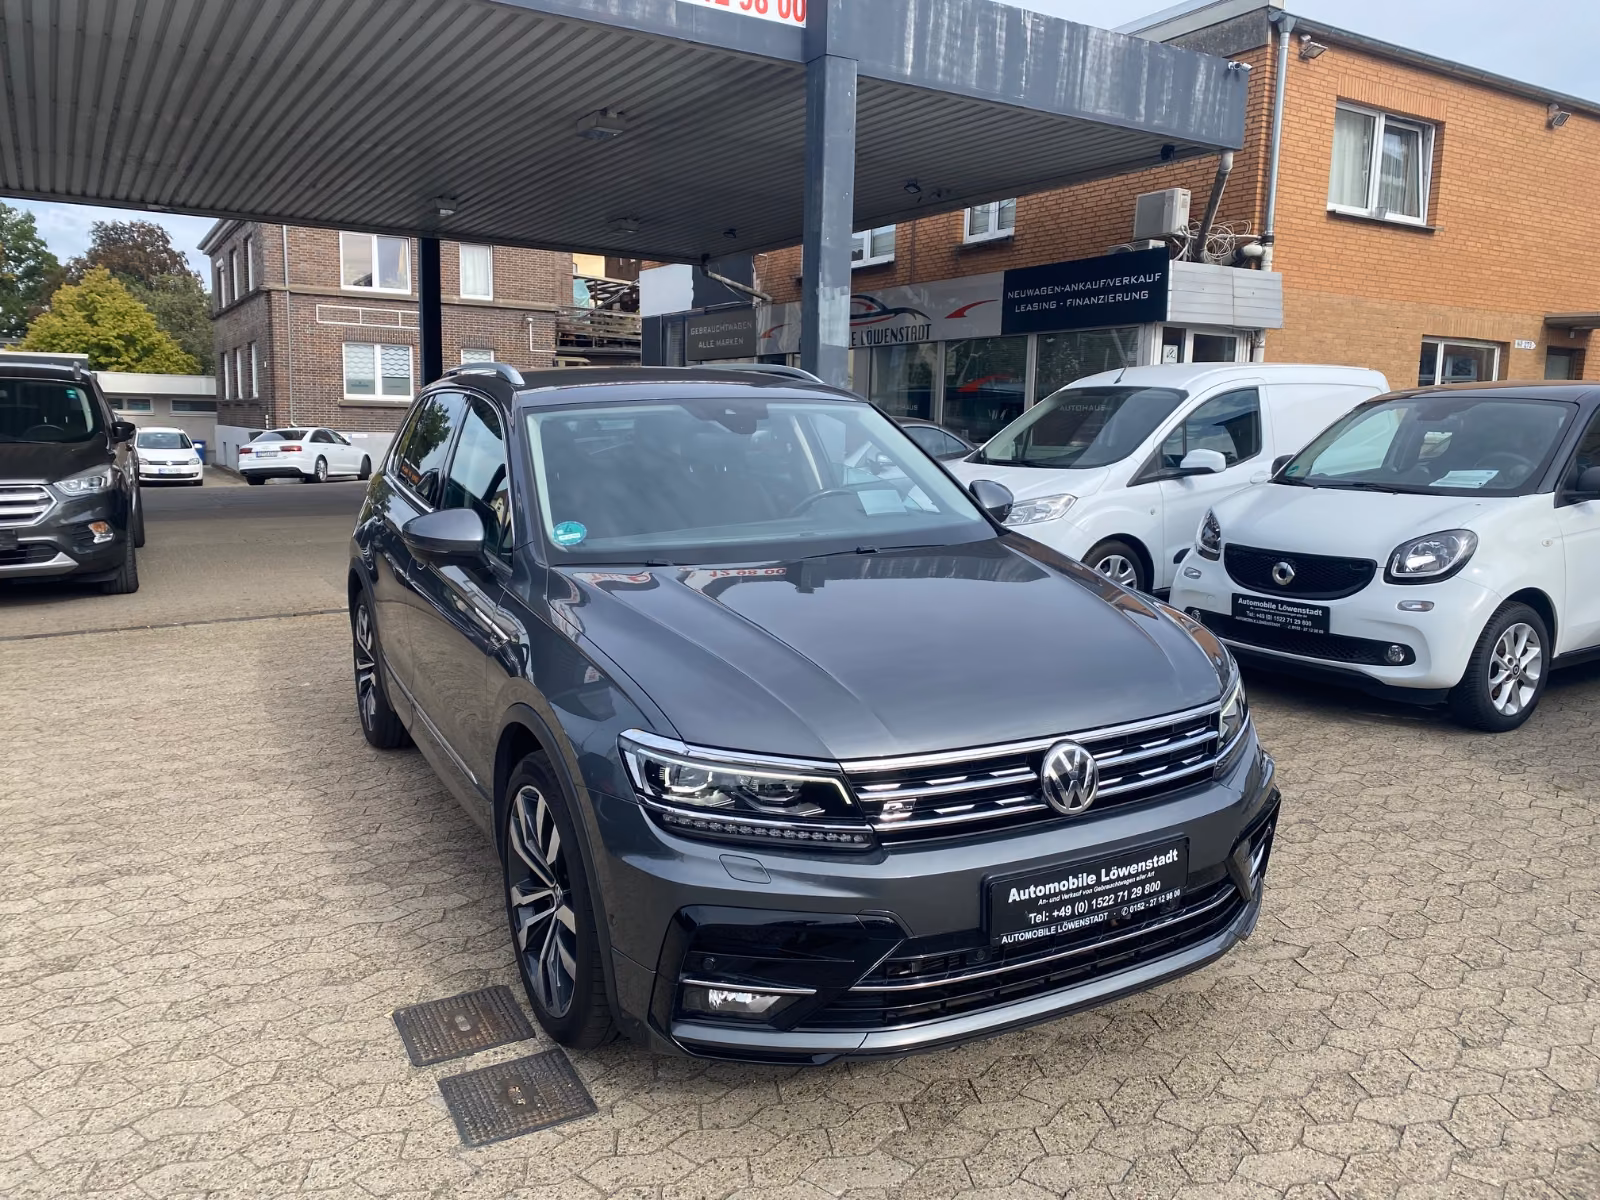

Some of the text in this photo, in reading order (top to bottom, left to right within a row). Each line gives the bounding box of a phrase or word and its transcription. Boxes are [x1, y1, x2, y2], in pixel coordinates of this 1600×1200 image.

[1007, 272, 1162, 299] NEUWAGEN-ANKAUF/VERKAUF
[1015, 300, 1057, 313] LEASING
[1066, 290, 1149, 307] FINANZIERUNG
[690, 321, 753, 336] GEBRAUCHTWAGEN
[861, 324, 932, 346] LÖWENSTADT
[698, 337, 744, 348] ALLE MARKEN
[1237, 597, 1276, 610] Automobile
[1278, 603, 1322, 616] Löwenstadt
[1007, 848, 1179, 903] Automobile Löwenstadt
[1049, 895, 1061, 904] und
[1061, 890, 1082, 901] Verkauf
[1082, 888, 1093, 896] von
[1146, 871, 1155, 879] Art
[1029, 880, 1161, 925] Tel: +49 (0) 1522 71 29 800
[1001, 925, 1057, 944] AUTOMOBILE
[1057, 911, 1109, 933] LÖWENSTADT
[1129, 902, 1145, 913] 0152
[1149, 899, 1158, 908] 27
[1158, 896, 1165, 905] 12
[1174, 888, 1181, 899] 00
